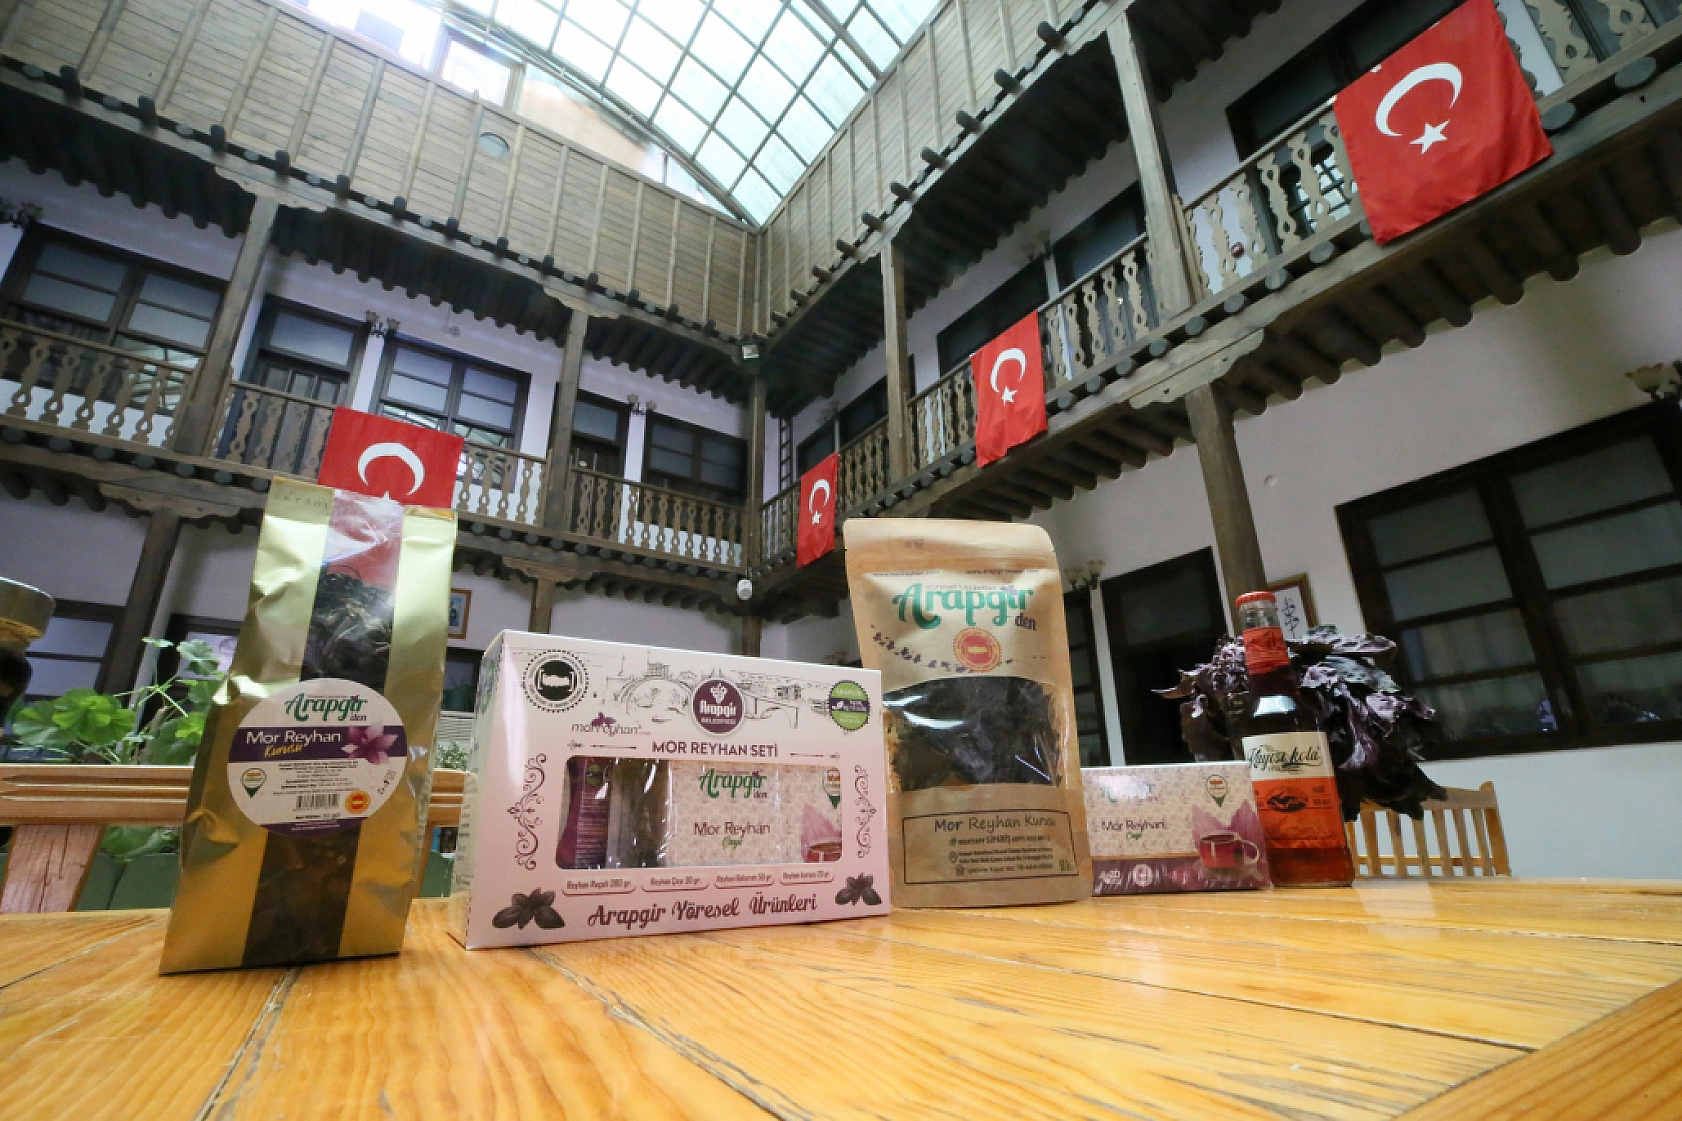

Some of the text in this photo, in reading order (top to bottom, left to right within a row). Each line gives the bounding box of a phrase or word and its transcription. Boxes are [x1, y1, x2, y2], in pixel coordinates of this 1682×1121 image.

[892, 583, 1033, 629] Arapgir
[284, 693, 368, 722] Arapgir
[246, 729, 341, 747] Mor Reyhan
[652, 741, 778, 759] MOR REYHAN SETİ
[699, 768, 767, 798] Arapgir
[694, 822, 770, 840] Mor Reyhan
[934, 818, 963, 833] Mor
[968, 816, 1020, 834] Reyhan
[1101, 820, 1165, 832] Mor Reyhan
[587, 892, 817, 930] Arapgir Yöresel Ürünleri
